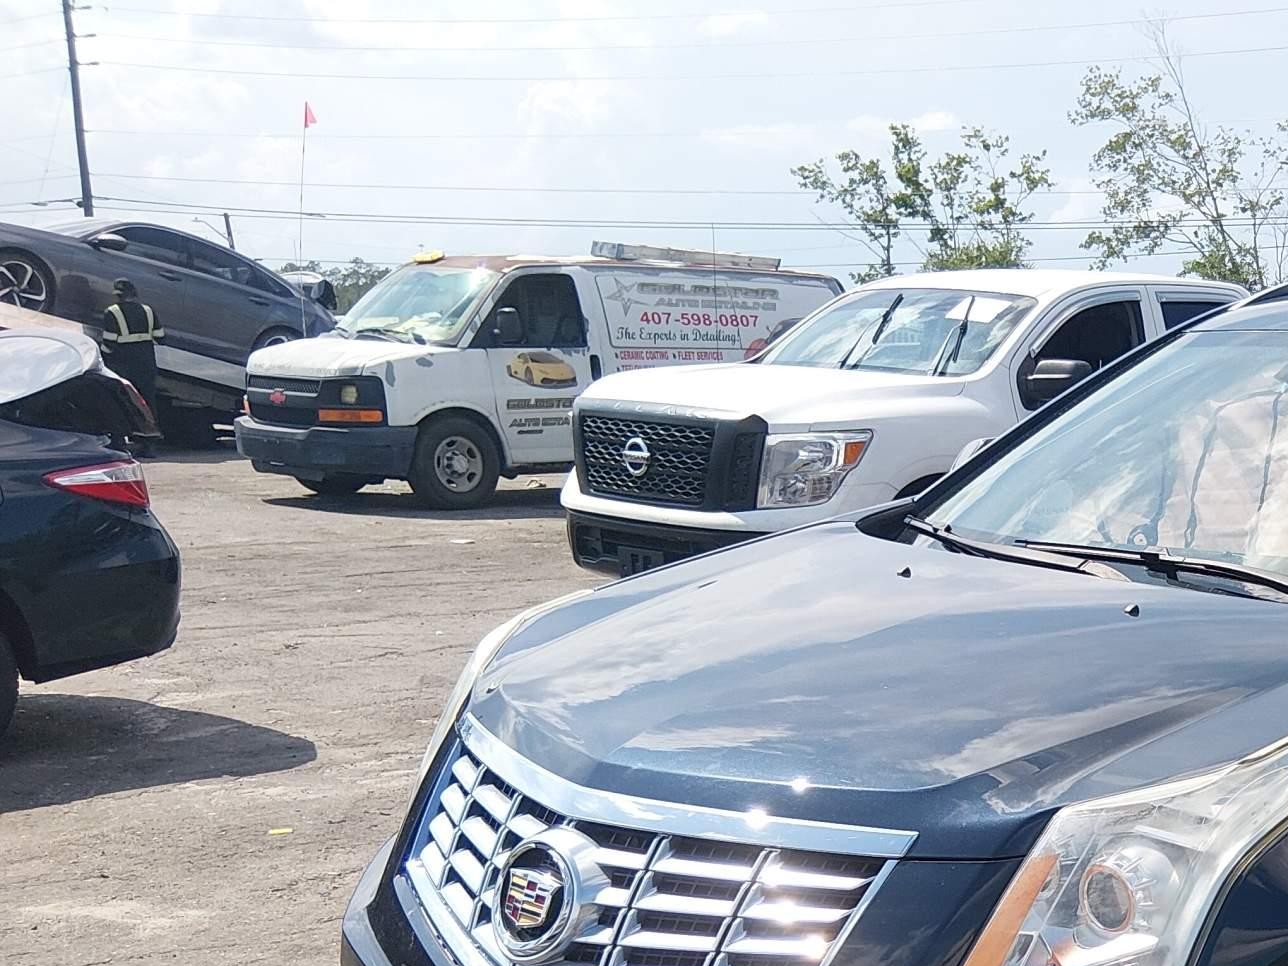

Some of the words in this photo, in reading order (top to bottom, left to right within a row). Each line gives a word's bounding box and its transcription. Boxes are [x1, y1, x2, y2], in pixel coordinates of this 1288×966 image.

[640, 312, 759, 327] 407-598-0807
[616, 327, 636, 341] The
[639, 327, 676, 345] Experts
[680, 329, 689, 341] in
[693, 328, 741, 346] Detailing!
[619, 351, 644, 360] CERAMIC
[646, 351, 669, 361] COATING
[678, 352, 696, 361] FLEET
[697, 352, 723, 361] SERVICES
